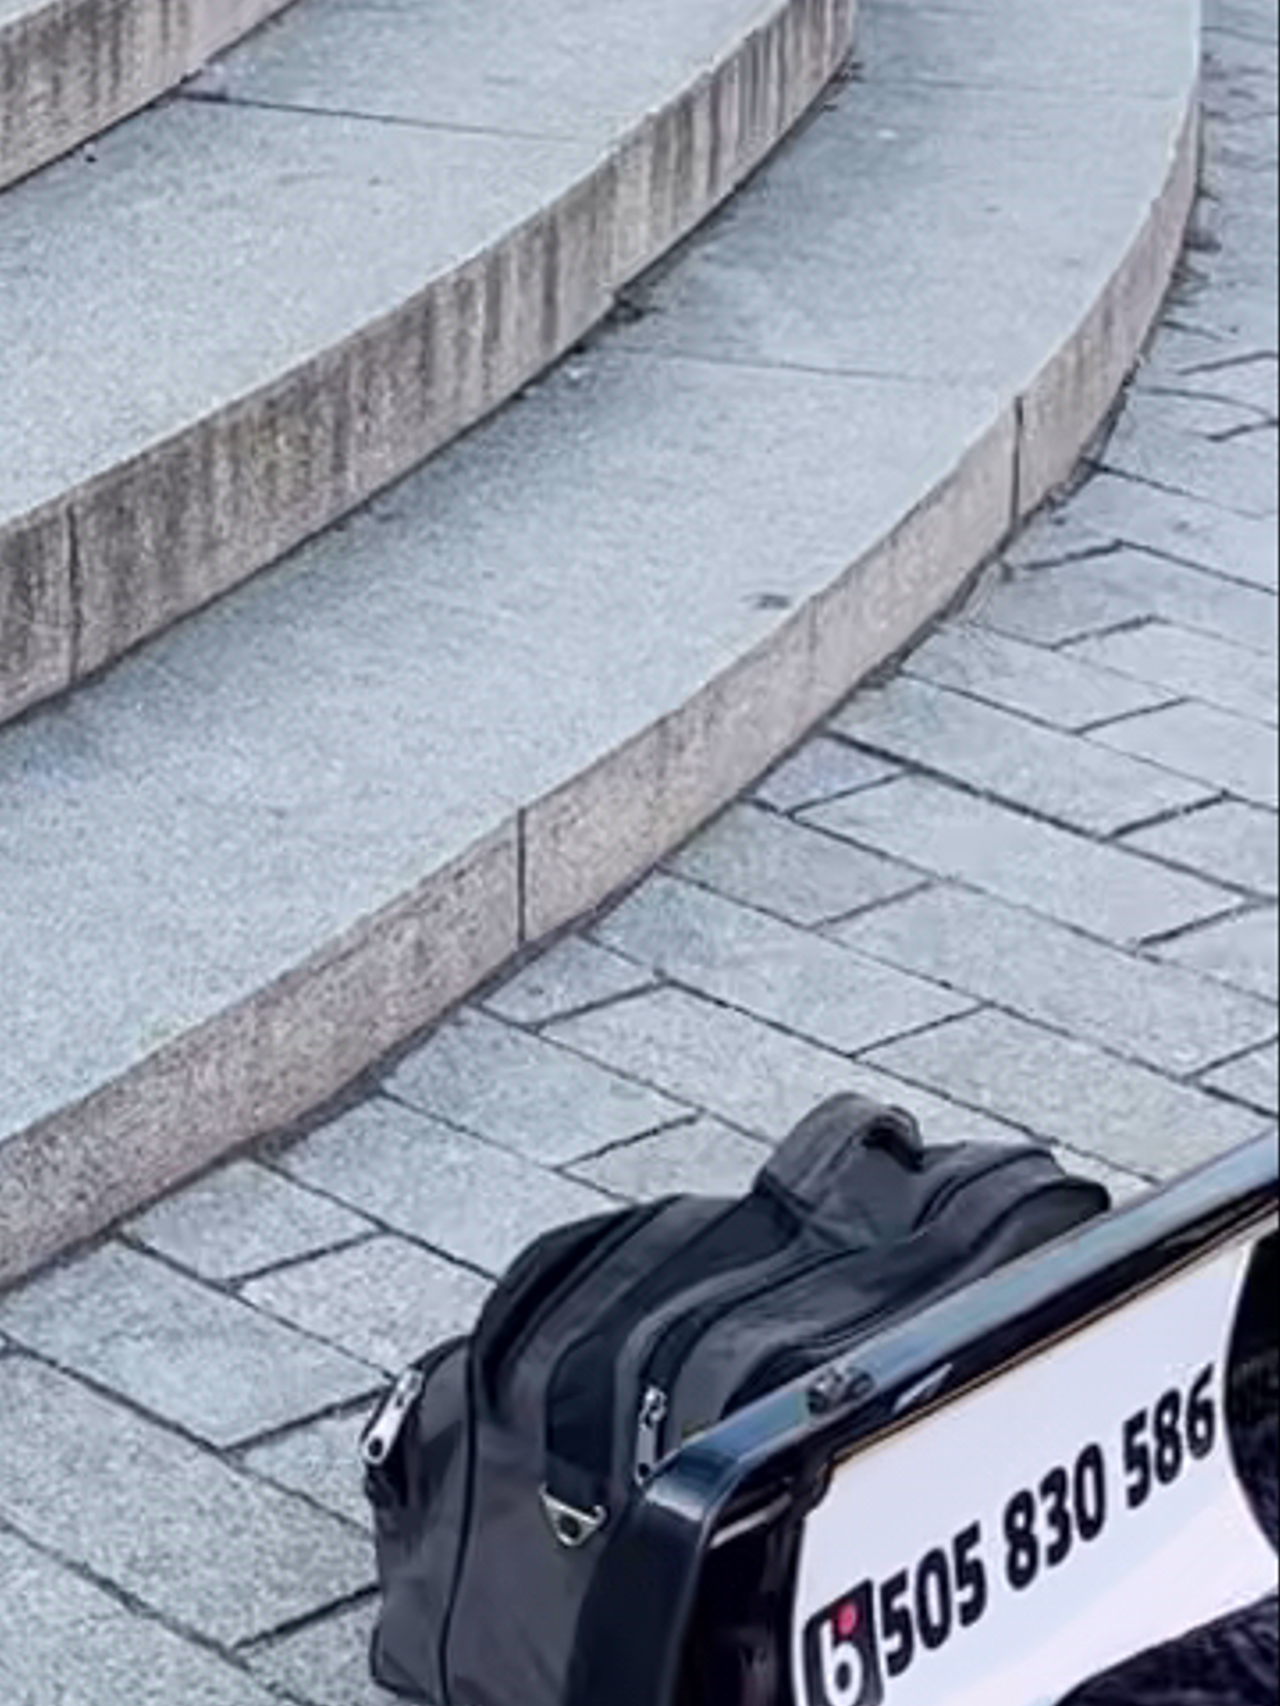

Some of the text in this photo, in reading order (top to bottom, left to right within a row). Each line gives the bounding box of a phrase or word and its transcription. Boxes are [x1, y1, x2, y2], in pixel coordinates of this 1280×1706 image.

[879, 1521, 988, 1677] 505
[1003, 1443, 1106, 1590] 830
[1122, 1363, 1216, 1510] 586
